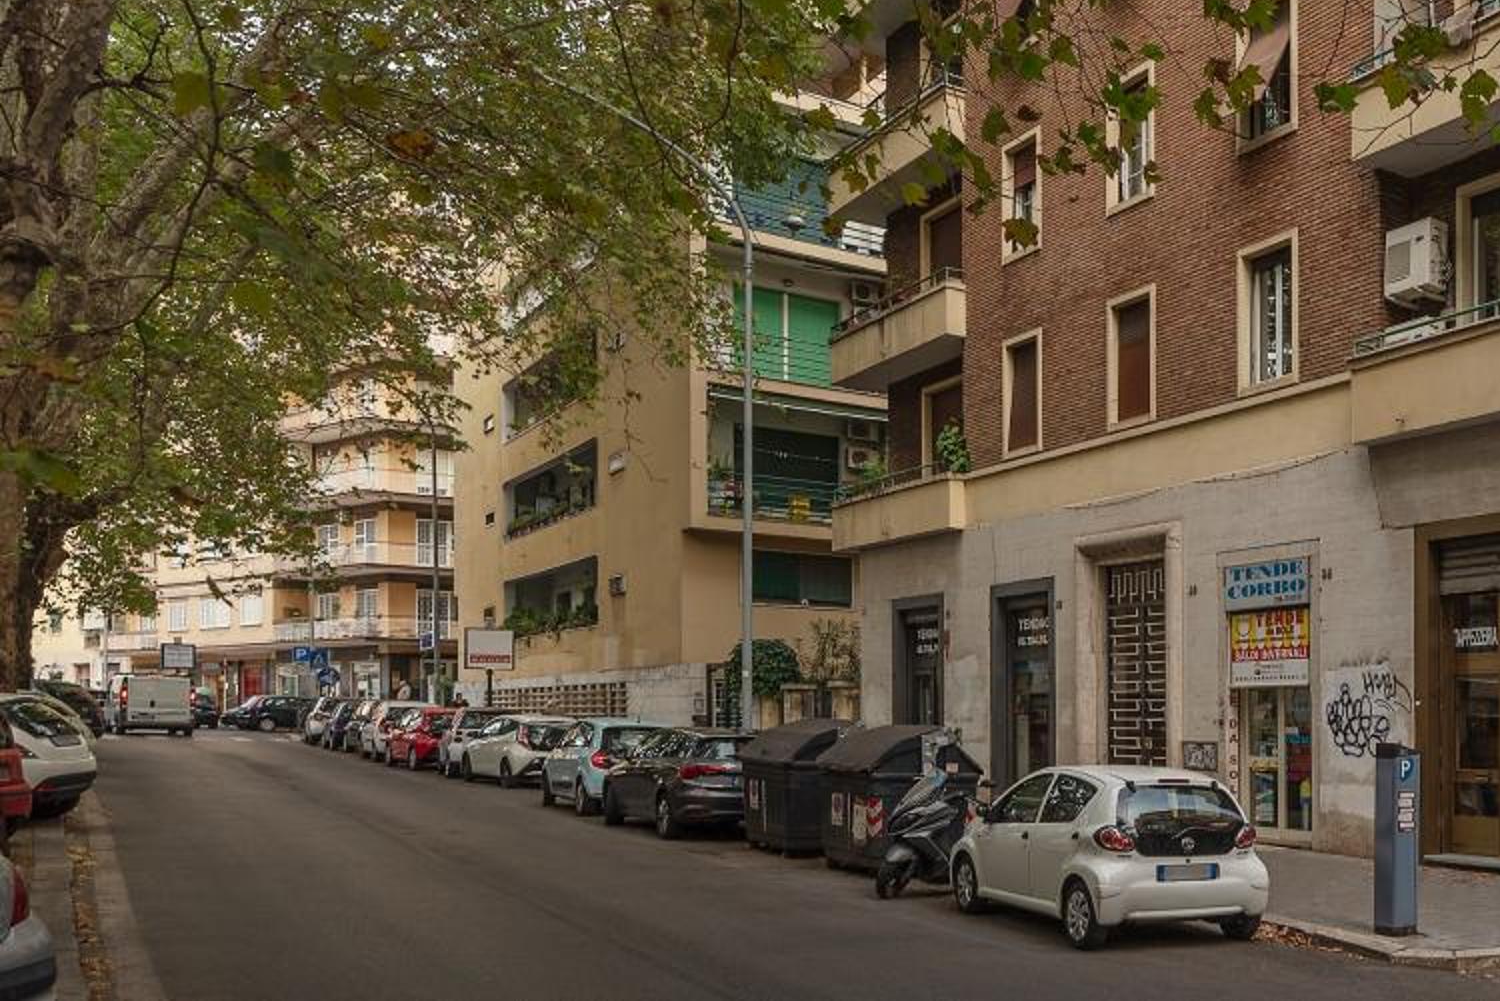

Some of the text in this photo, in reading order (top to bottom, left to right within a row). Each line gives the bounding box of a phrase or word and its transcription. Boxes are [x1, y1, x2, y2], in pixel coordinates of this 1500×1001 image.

[1230, 560, 1305, 582] TENDE
[1227, 579, 1306, 599] CORBO
[1256, 611, 1305, 628] TENDE
[1401, 760, 1411, 778] P
